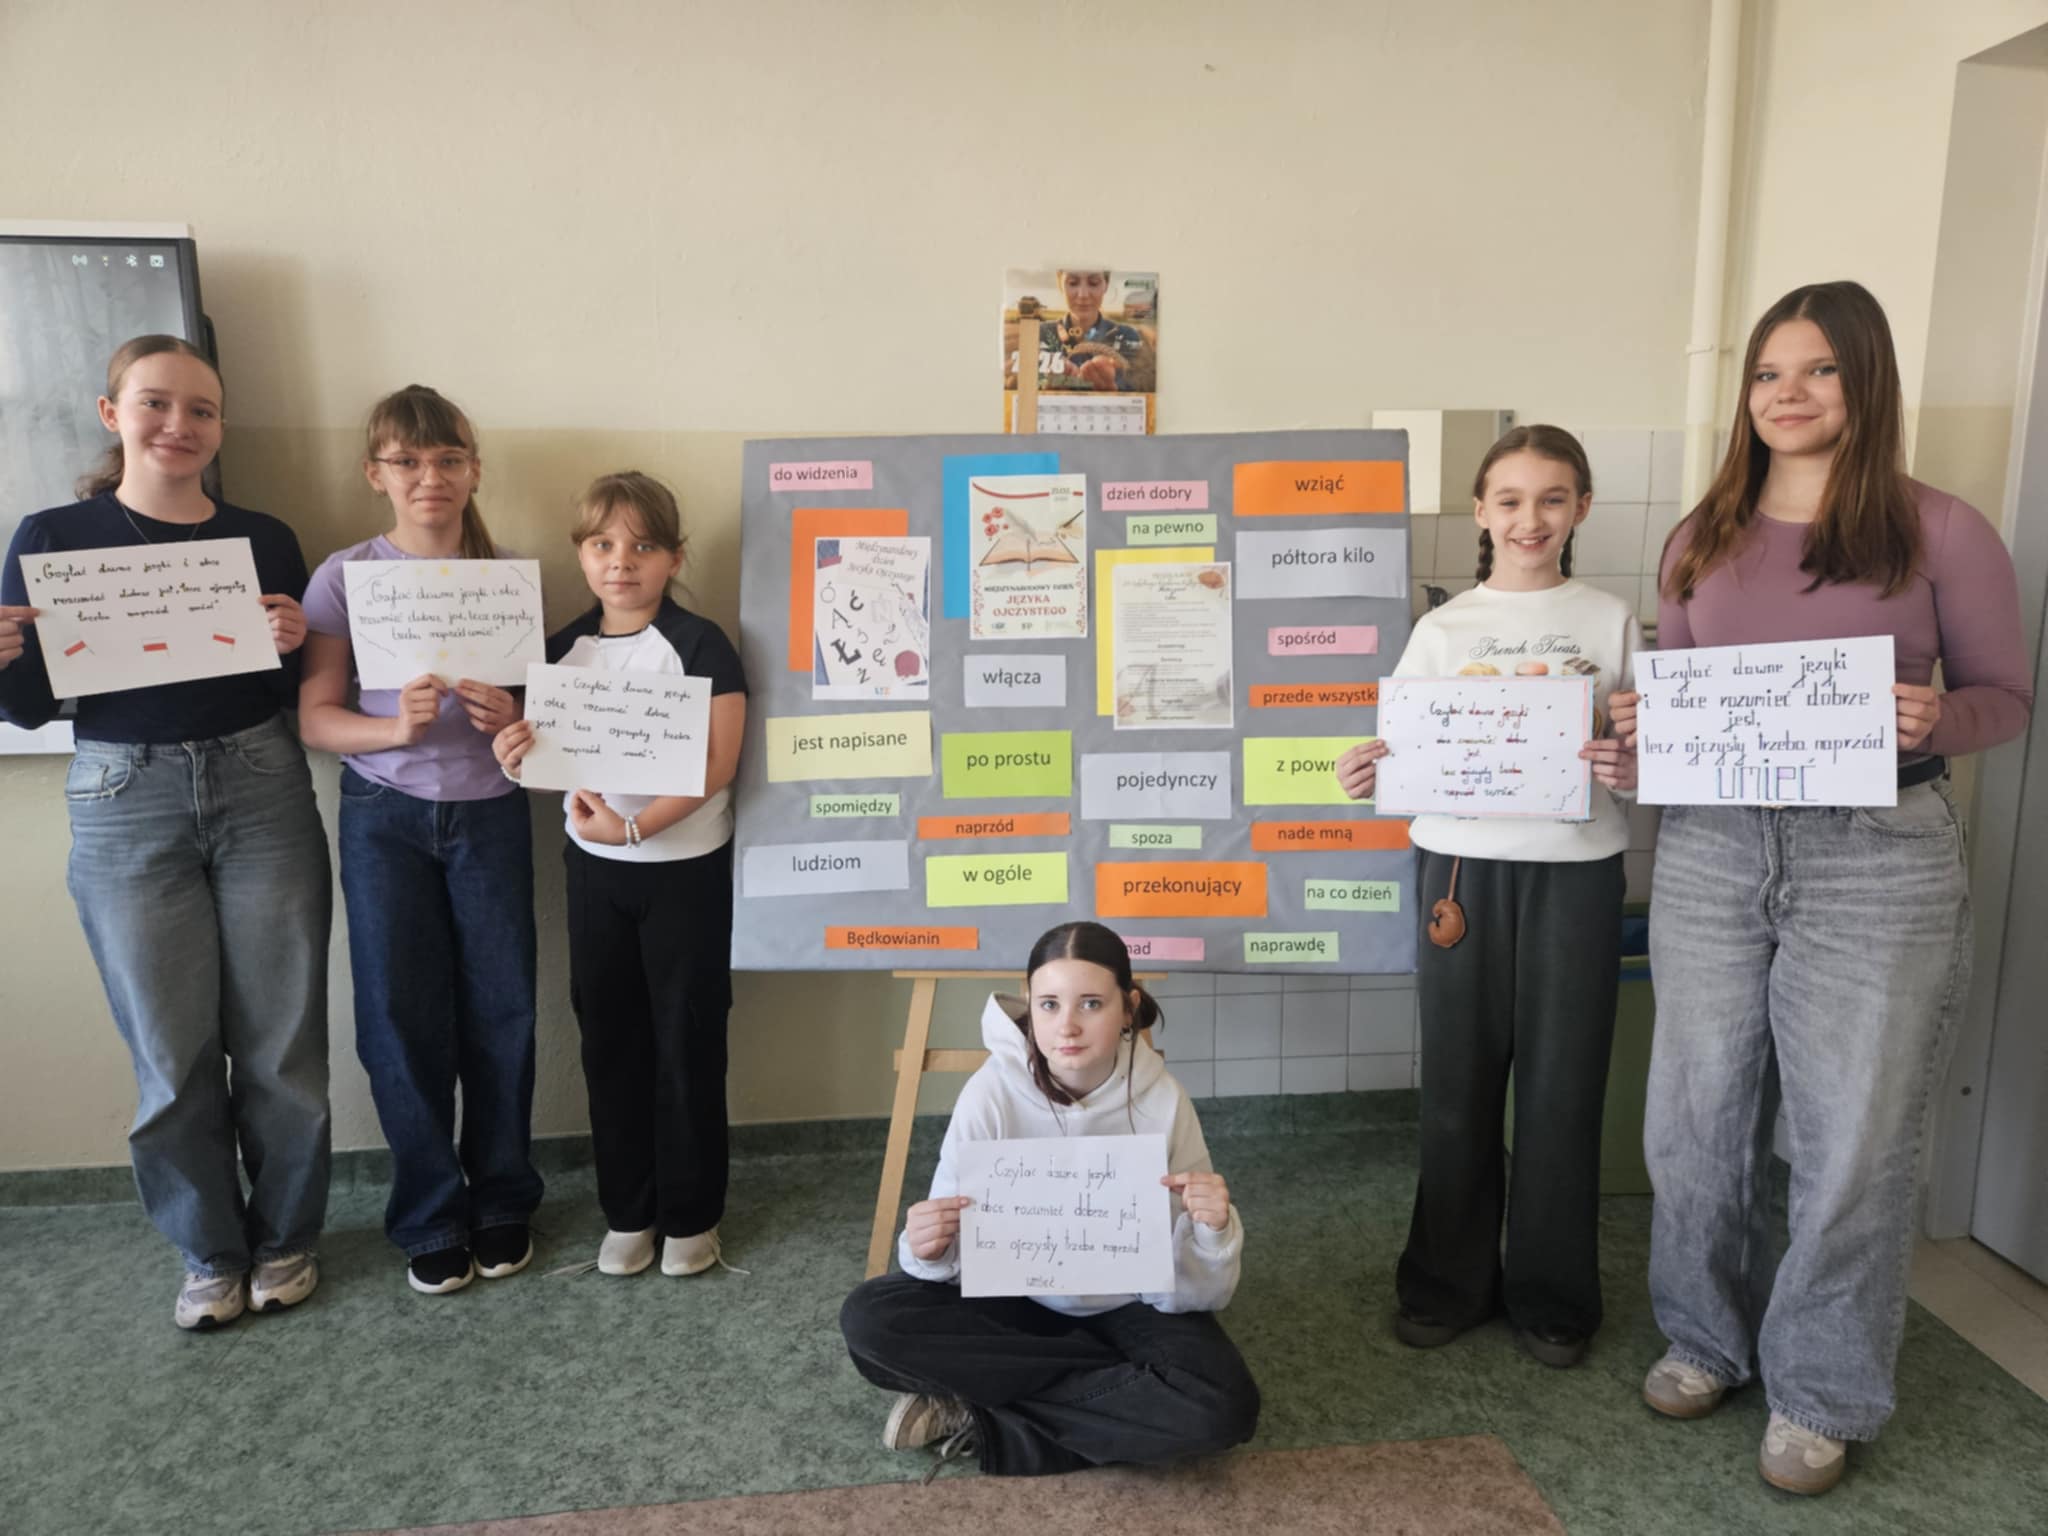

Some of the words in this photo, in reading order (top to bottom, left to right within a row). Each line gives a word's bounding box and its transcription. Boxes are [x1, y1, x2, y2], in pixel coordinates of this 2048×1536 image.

[774, 466, 793, 481] do
[796, 466, 858, 480] widzenia
[1295, 475, 1344, 492] wziąć
[1106, 486, 1145, 500] dzień
[1149, 486, 1192, 502] dobry
[1132, 524, 1149, 534] na
[1154, 521, 1204, 536] pewno
[1271, 549, 1337, 567] półtora
[1343, 547, 1375, 563] kilo
[1006, 594, 1051, 605] JĘZYKA
[993, 606, 1067, 616] OJCZYSTEGO
[1277, 632, 1337, 647] spośród
[1469, 636, 1529, 659] French
[1532, 634, 1582, 655] Treats
[983, 668, 1042, 687] włącza
[1263, 688, 1314, 704] przede
[1318, 686, 1379, 704] wszystki
[1643, 693, 1650, 709] i
[1671, 691, 1707, 708] obce
[1720, 688, 1791, 708] rozumieć
[1806, 681, 1871, 706] dobrze
[792, 735, 823, 754] jest
[829, 731, 908, 751] napisane
[1814, 725, 1886, 764] naprzód
[966, 754, 989, 770] po
[994, 751, 1051, 768] prostu
[1276, 760, 1285, 772] z
[1116, 772, 1218, 791] pojedynczy
[815, 800, 893, 816] spomiędzy
[955, 819, 1015, 836] naprzód
[1278, 826, 1315, 839] nade
[1319, 829, 1353, 842] mną
[1131, 832, 1173, 848] spoza
[792, 854, 862, 871] ludziom
[963, 869, 978, 882] w
[983, 864, 1033, 884] ogóle
[1123, 877, 1242, 896] przekonujący
[1306, 888, 1325, 899] na
[1329, 888, 1348, 899] co
[1351, 886, 1392, 901] dzień
[847, 930, 940, 947] Będkowianin
[1250, 937, 1326, 954] naprawdę
